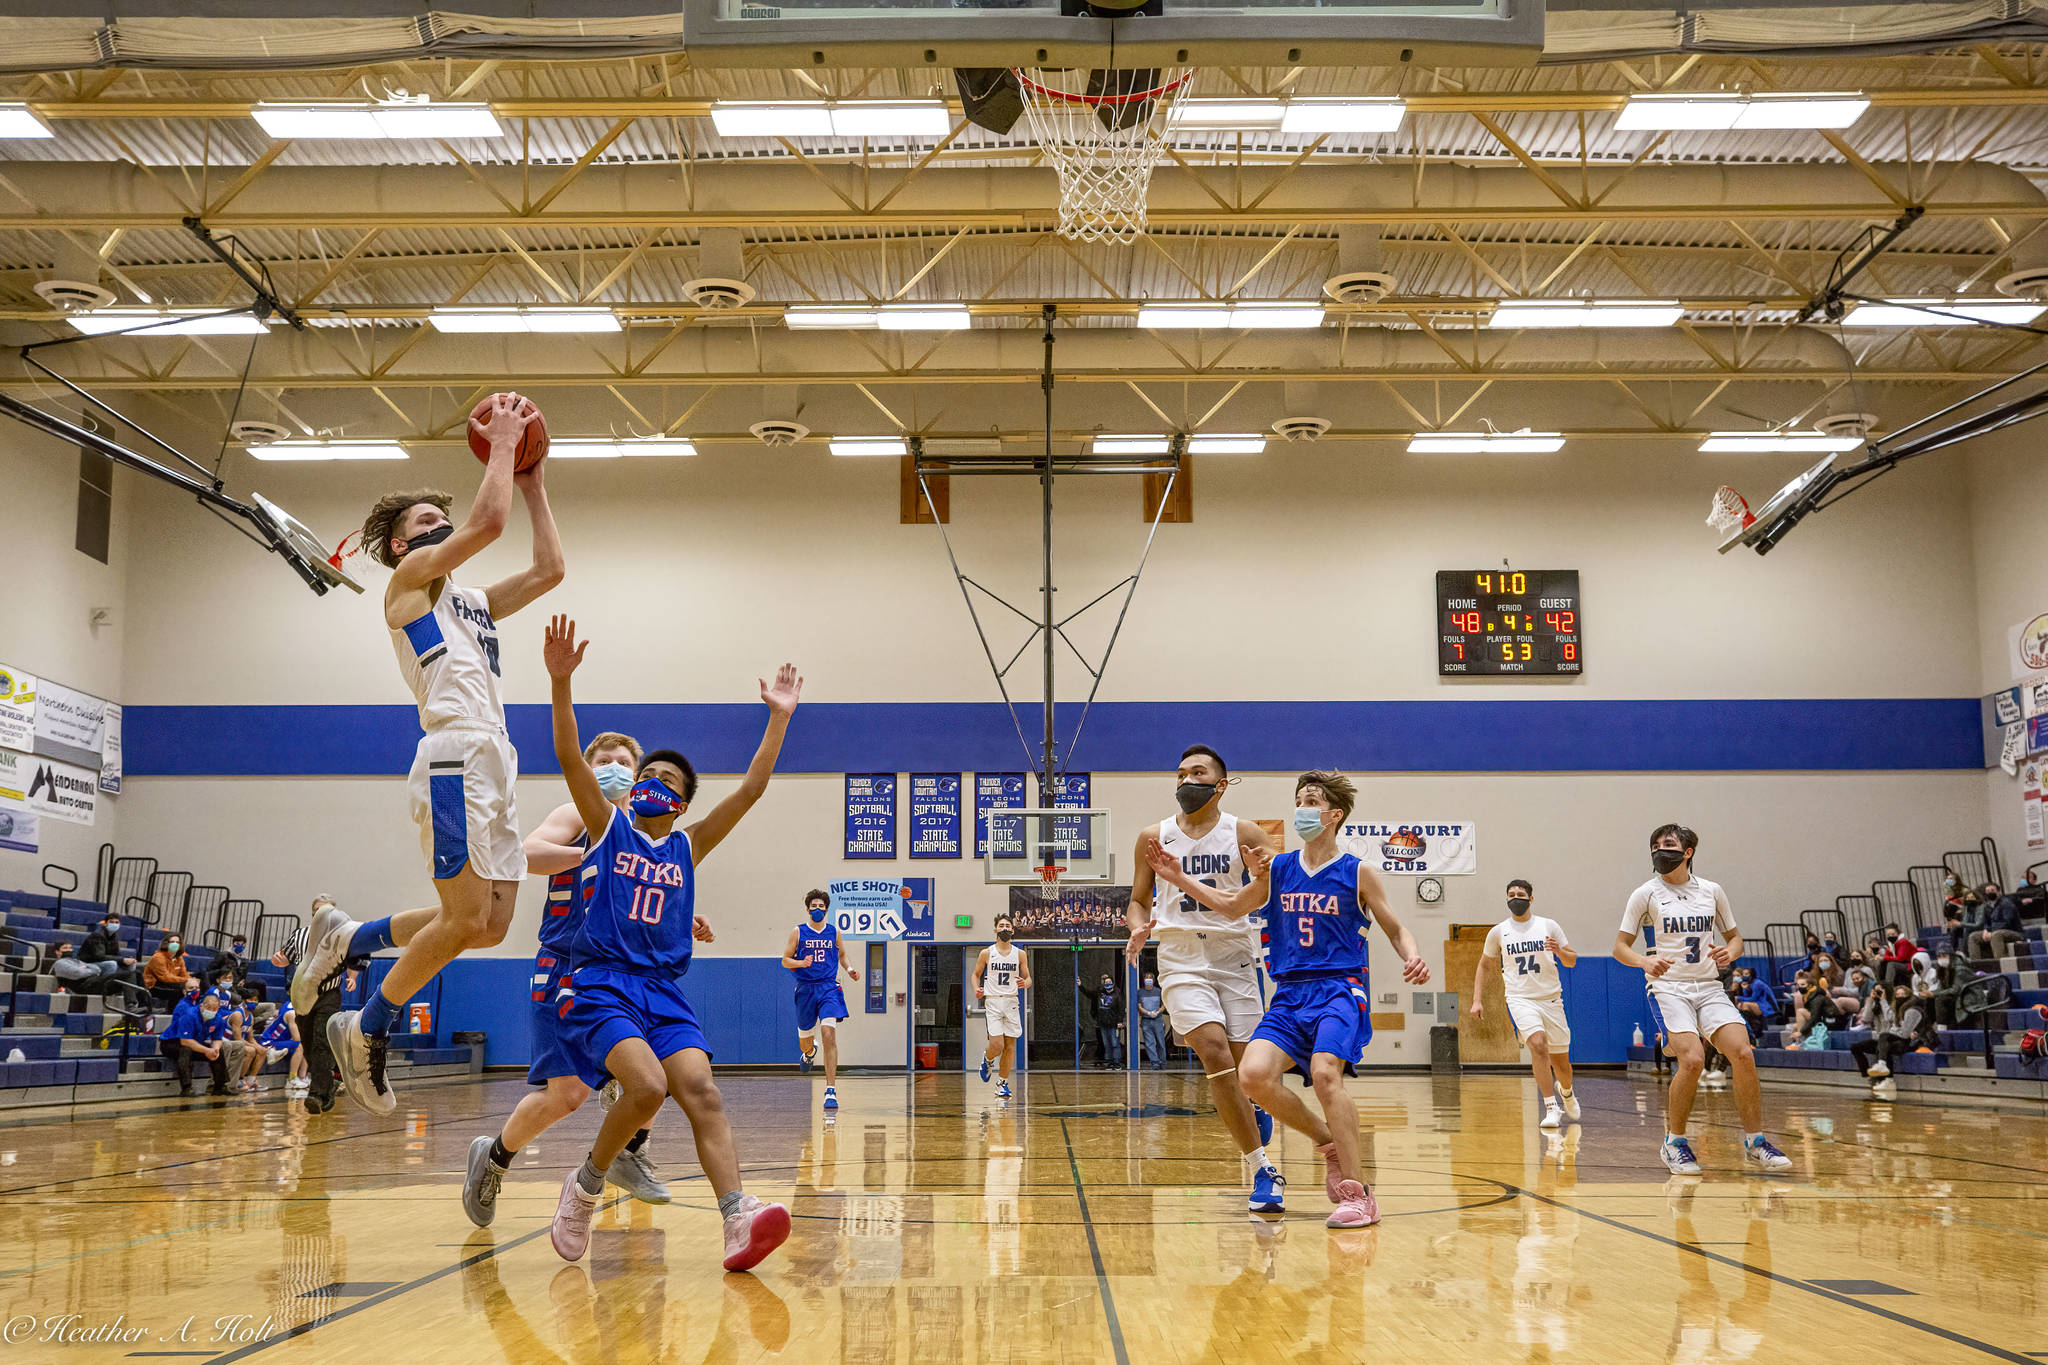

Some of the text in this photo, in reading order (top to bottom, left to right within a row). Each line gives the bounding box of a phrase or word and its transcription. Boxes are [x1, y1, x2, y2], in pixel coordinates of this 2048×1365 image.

[1477, 573, 1526, 595] 41.0
[1448, 599, 1476, 609] HOME
[1497, 604, 1522, 612] PERIOD
[1540, 599, 1572, 609] GUEST
[1452, 612, 1481, 633] 48
[1504, 615, 1516, 630] 4
[1546, 612, 1574, 633] 42
[1453, 644, 1464, 660] 7
[1502, 644, 1532, 660] 5 3
[1564, 644, 1576, 660] 8
[648, 790, 672, 804] SITKA
[849, 804, 892, 816] SOFTBALL
[914, 804, 957, 816] SOFTBALL
[858, 830, 884, 840] STATE
[922, 830, 948, 840] STATE
[993, 829, 1013, 840] TATE
[1345, 826, 1462, 836] FULL COURT
[848, 840, 892, 852] CHAMPIONS
[914, 840, 957, 852] CHAMPIONS
[978, 840, 1022, 852] CHMPIONS
[614, 851, 684, 888] SITKA
[1182, 854, 1230, 875] LCONS
[1382, 862, 1428, 871] CLUB
[830, 880, 898, 894] NICE SHOT!
[628, 884, 665, 924] 10
[1280, 892, 1340, 916] SITKA
[1298, 916, 1314, 948] 5
[806, 940, 832, 948] SITKA
[1506, 940, 1545, 956] FALCONS
[1685, 936, 1700, 964] 3
[814, 950, 825, 962] 12
[991, 962, 1016, 972] FALCONS
[1514, 955, 1541, 976] 24
[998, 972, 1010, 986] 12
